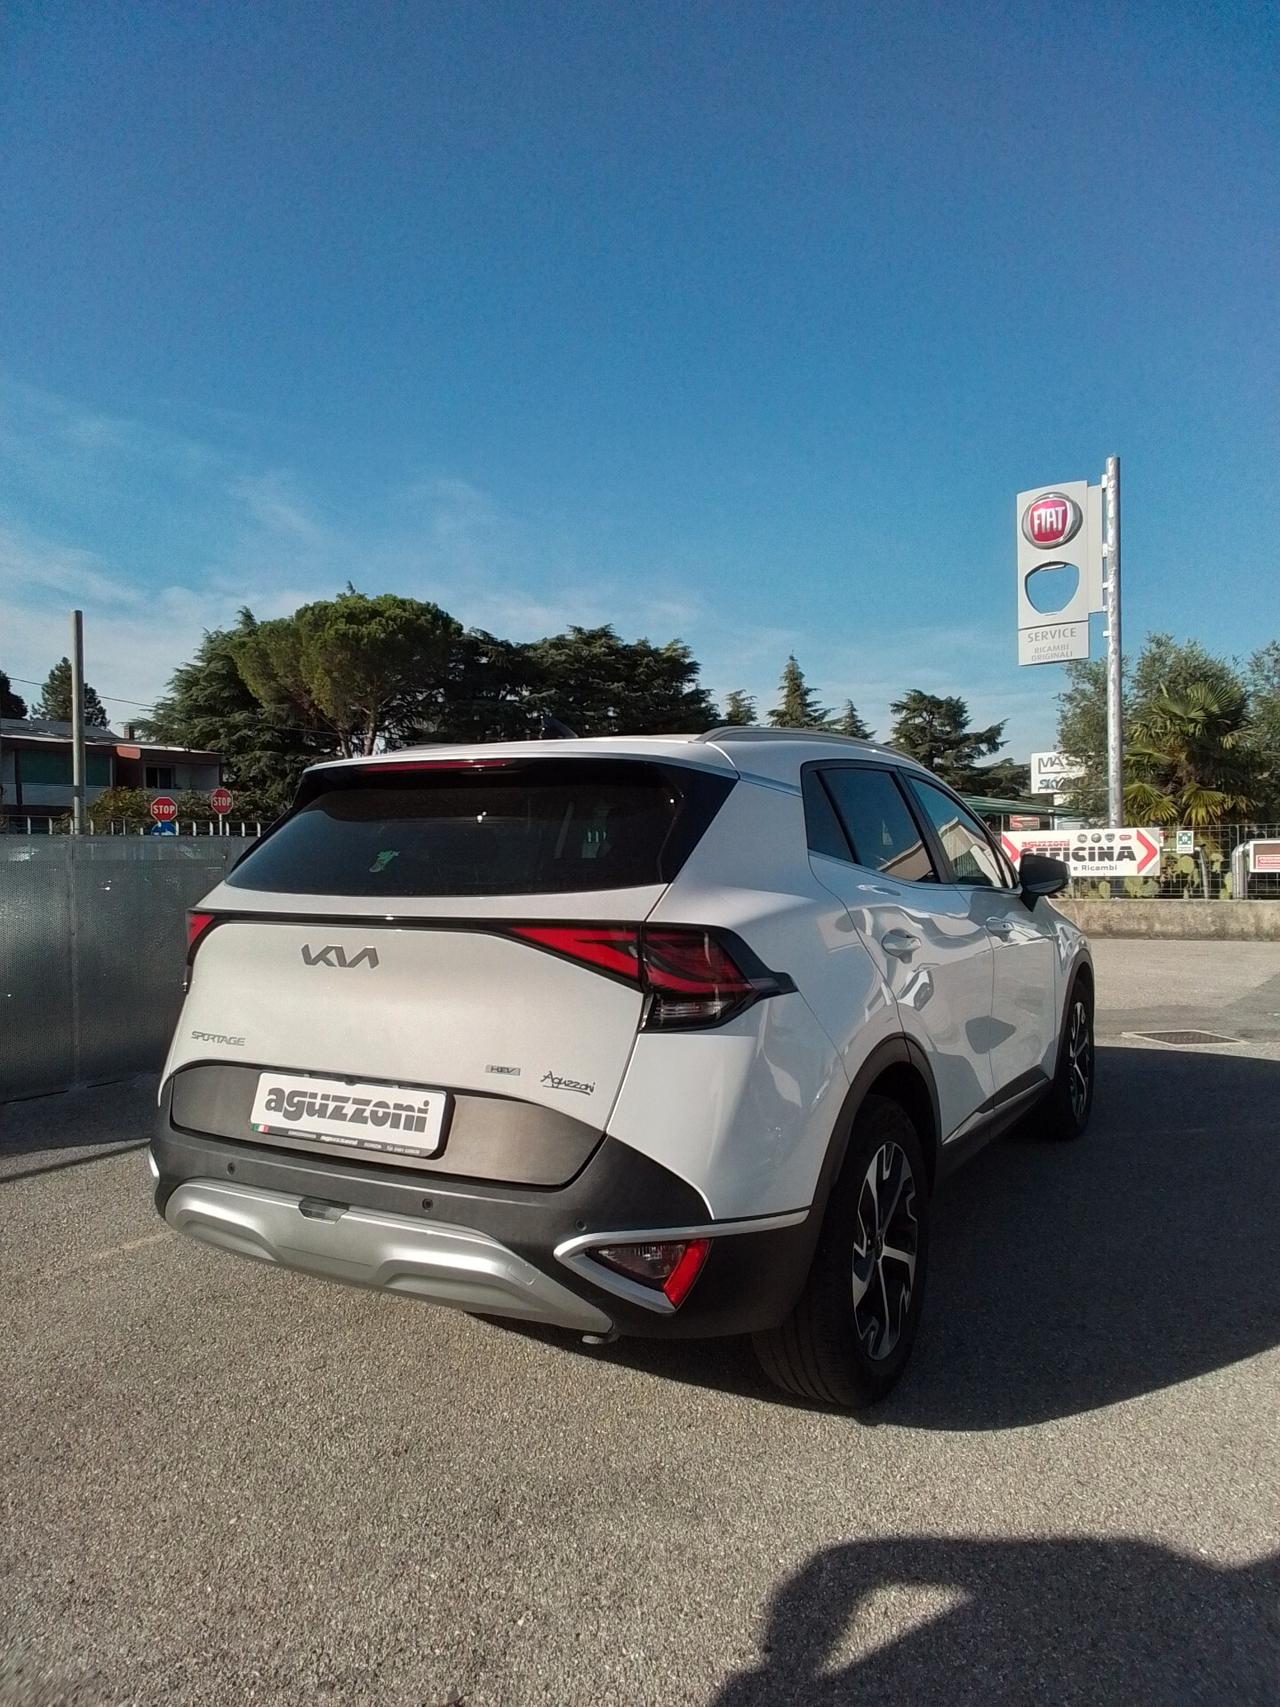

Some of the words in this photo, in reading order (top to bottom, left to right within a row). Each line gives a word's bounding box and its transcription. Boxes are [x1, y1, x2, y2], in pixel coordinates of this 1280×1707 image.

[1033, 506, 1065, 535] FIAT
[1027, 627, 1077, 643] SERVICE
[1031, 650, 1073, 661] ORIGINALI
[1034, 643, 1070, 654] RICAMBI
[153, 805, 175, 814] STOP
[213, 796, 232, 807] STOP
[301, 943, 380, 969] KIA
[191, 1030, 246, 1046] SPORTAGE
[490, 1065, 515, 1074] HEV
[540, 1070, 596, 1096] Aguzzoni
[264, 1086, 430, 1133] aguzzoni
